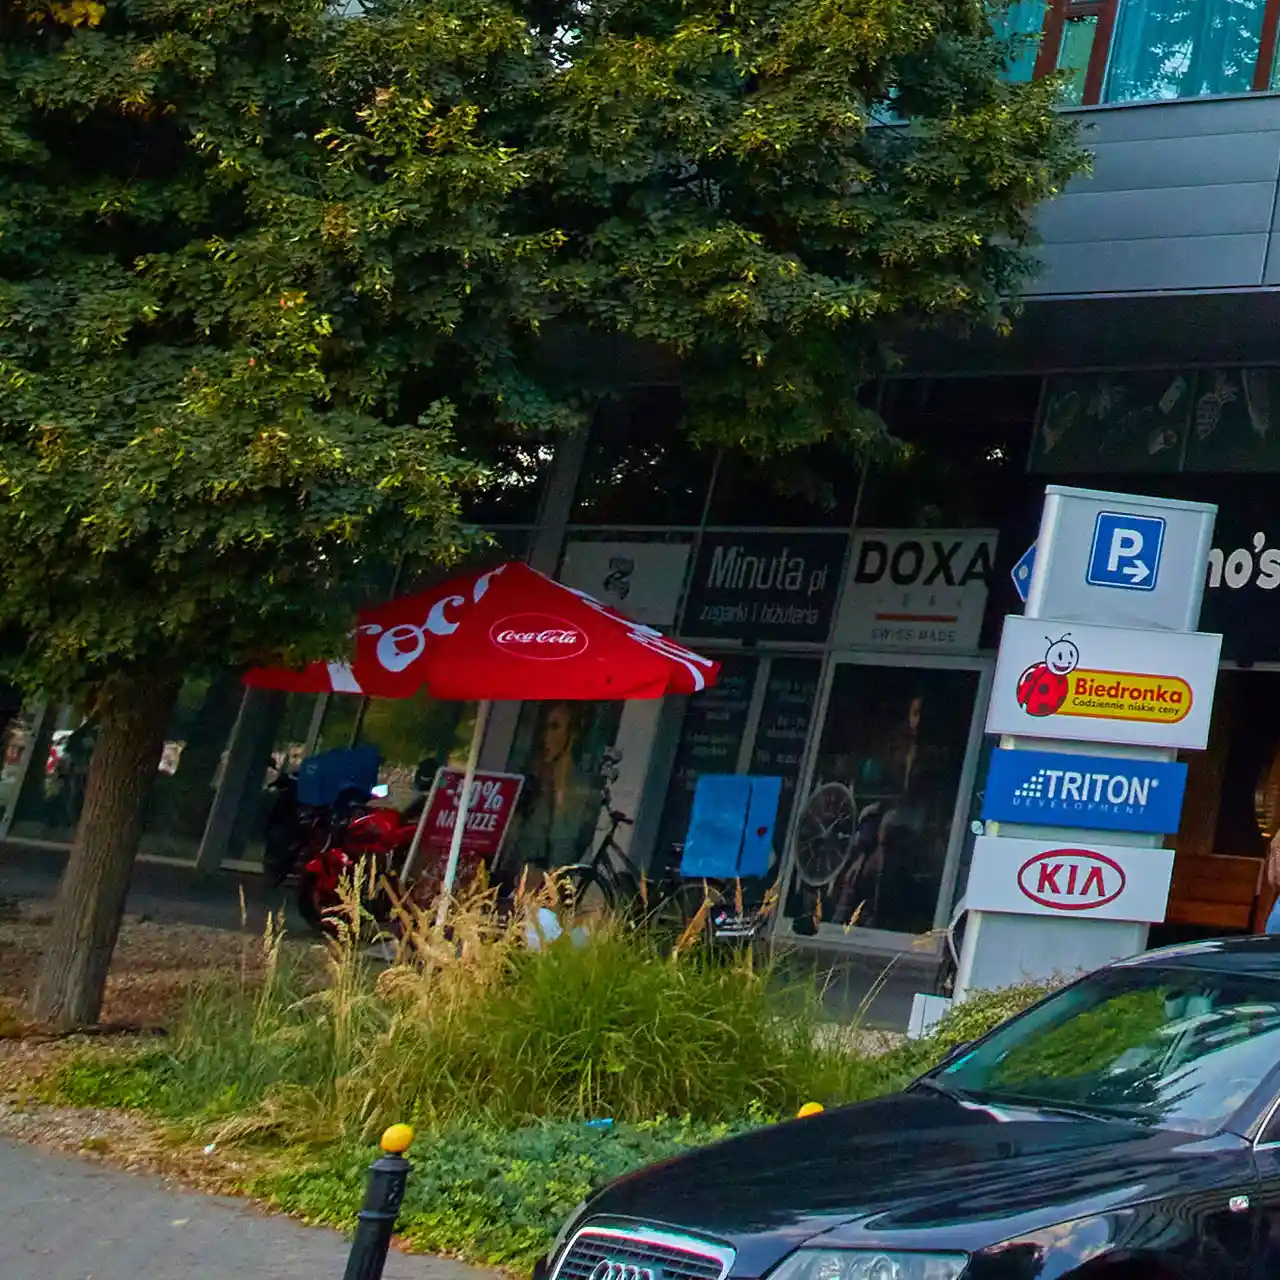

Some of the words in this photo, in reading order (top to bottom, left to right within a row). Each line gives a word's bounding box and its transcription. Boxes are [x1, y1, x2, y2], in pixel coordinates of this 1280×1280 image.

[854, 540, 991, 586] DOXA
[1107, 527, 1144, 571] P
[707, 544, 804, 590] Minuta
[1072, 697, 1125, 710] Codziennie
[1128, 702, 1156, 713] niskie
[1158, 706, 1180, 715] ceny
[1074, 678, 1183, 703] Biedronka
[1046, 770, 1150, 806] TRITON
[464, 812, 499, 831] IZZE
[1012, 798, 1146, 814] DEVELOPMENT
[1037, 862, 1106, 897] KIA
